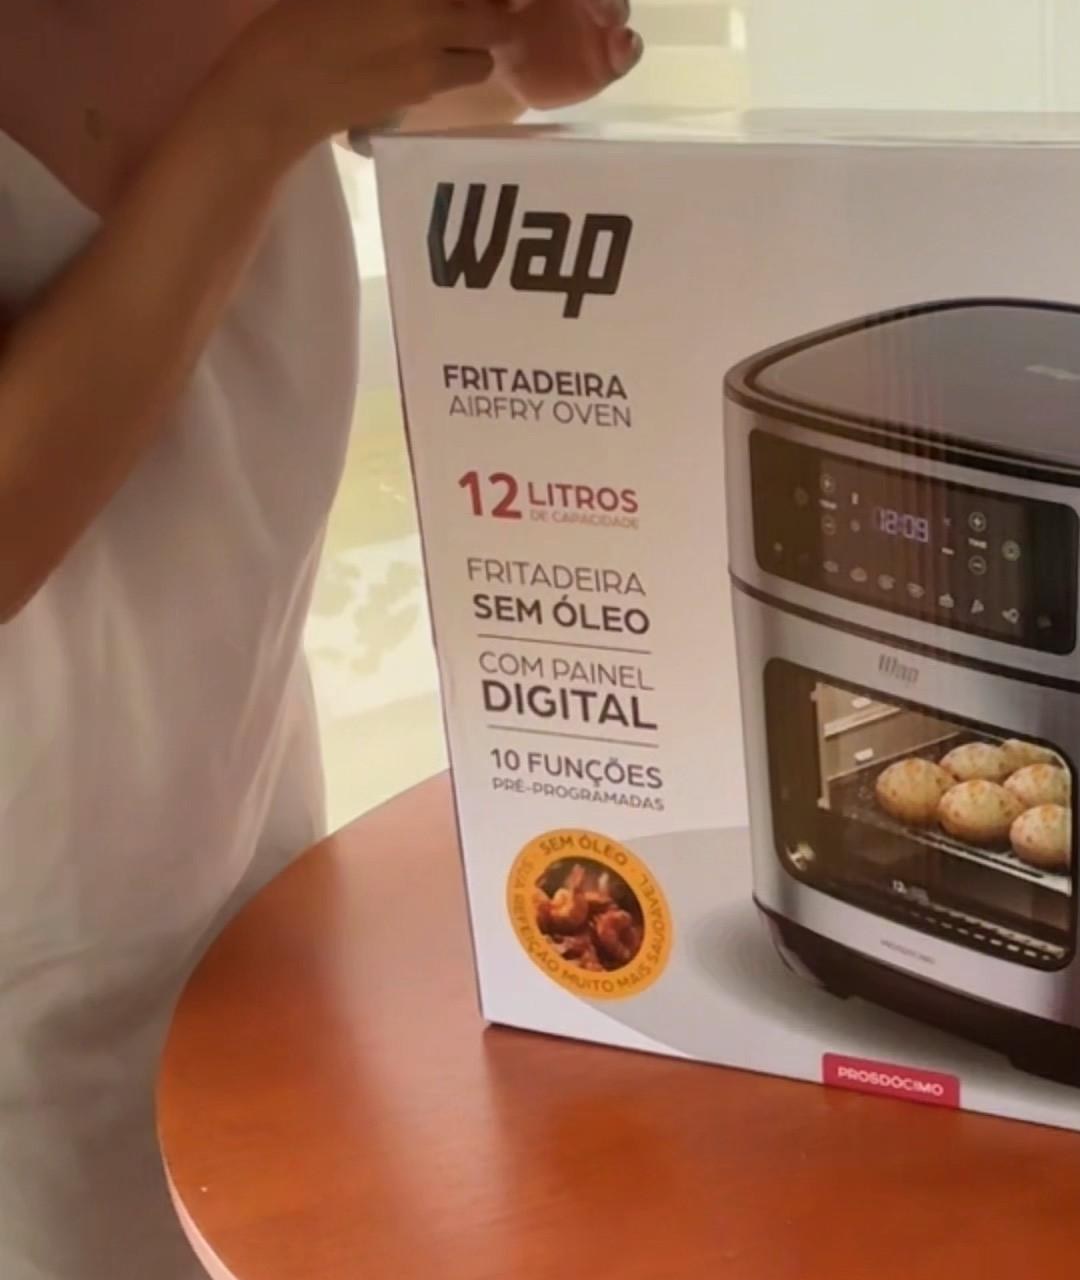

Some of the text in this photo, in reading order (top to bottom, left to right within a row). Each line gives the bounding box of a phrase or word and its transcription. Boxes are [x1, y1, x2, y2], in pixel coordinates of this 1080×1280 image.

[427, 182, 633, 319] Wap
[443, 364, 628, 400] FRITADEIRA
[449, 395, 631, 428] AIRFRY OVEN
[458, 471, 639, 520] 12 LITROS
[530, 509, 548, 522] DE
[467, 557, 647, 597] FRITADEIRA
[473, 593, 650, 635] SEM ÓLEO
[479, 651, 655, 691] COM PAINEL
[482, 679, 658, 730] DIGITAL
[490, 748, 663, 789] 10 FUNÇÕES
[492, 777, 665, 811] PRÉ-PROGRAMADAS
[539, 834, 628, 867] SEM ÓLEO
[561, 970, 615, 993] MUITO
[616, 963, 652, 988] MAIS
[837, 1066, 944, 1097] PROSDOCIMO
